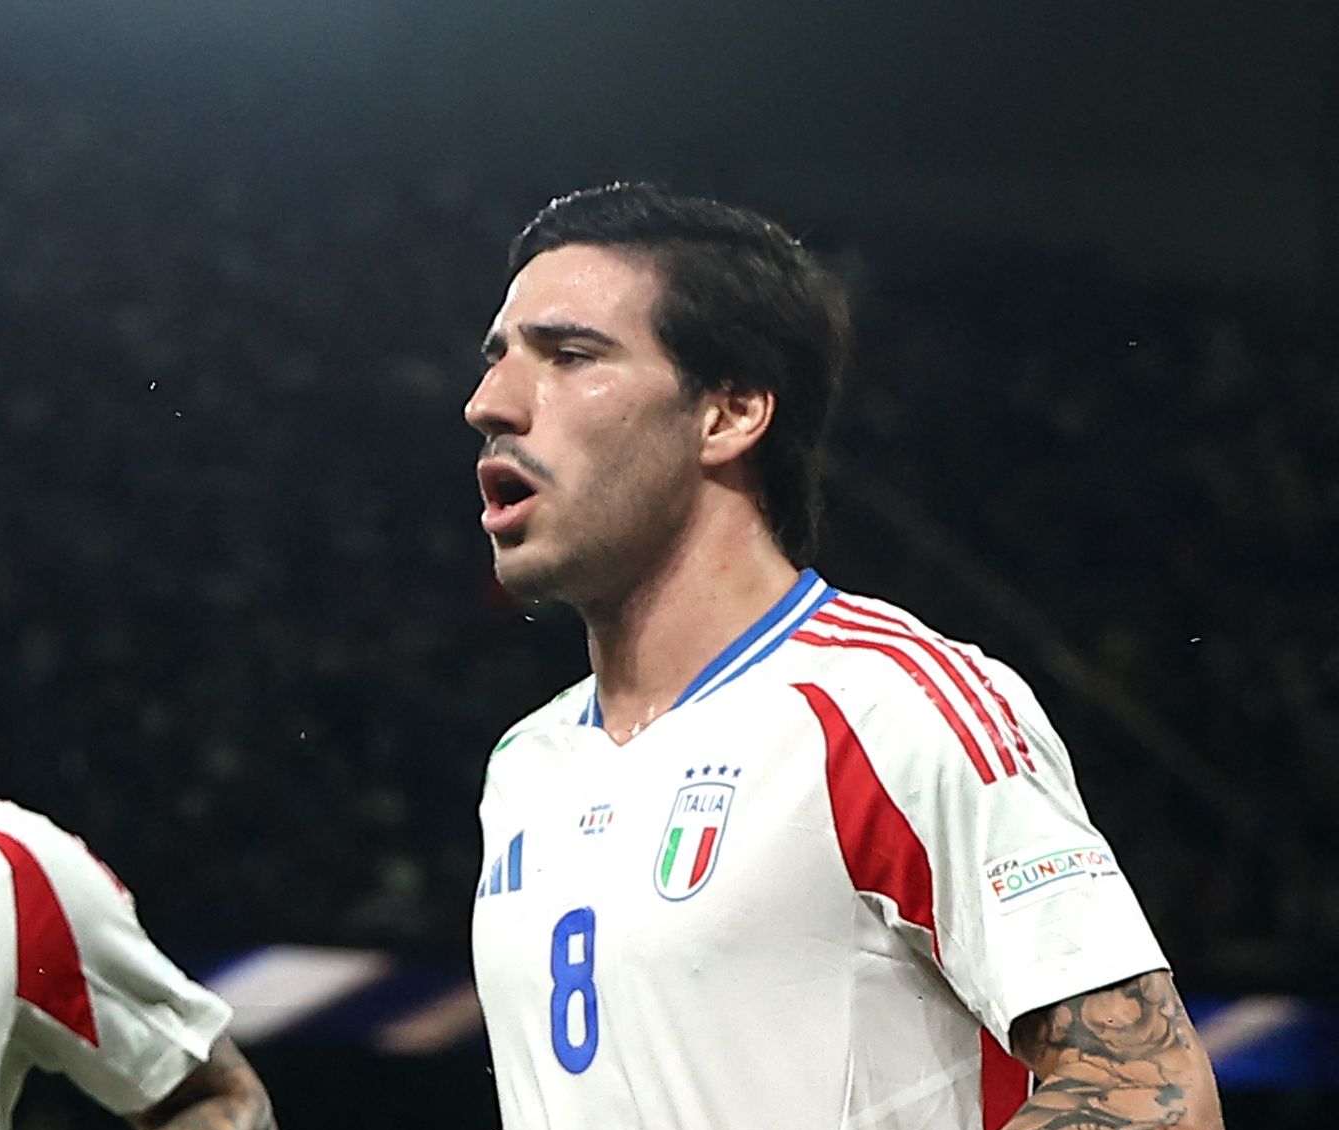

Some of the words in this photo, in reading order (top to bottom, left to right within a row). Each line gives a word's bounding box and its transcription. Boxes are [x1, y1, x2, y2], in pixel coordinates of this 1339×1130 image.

[677, 794, 724, 812] ITALIA
[987, 859, 1019, 879] UEFA
[991, 851, 1112, 897] FOUNDATION
[550, 905, 599, 1075] 8
